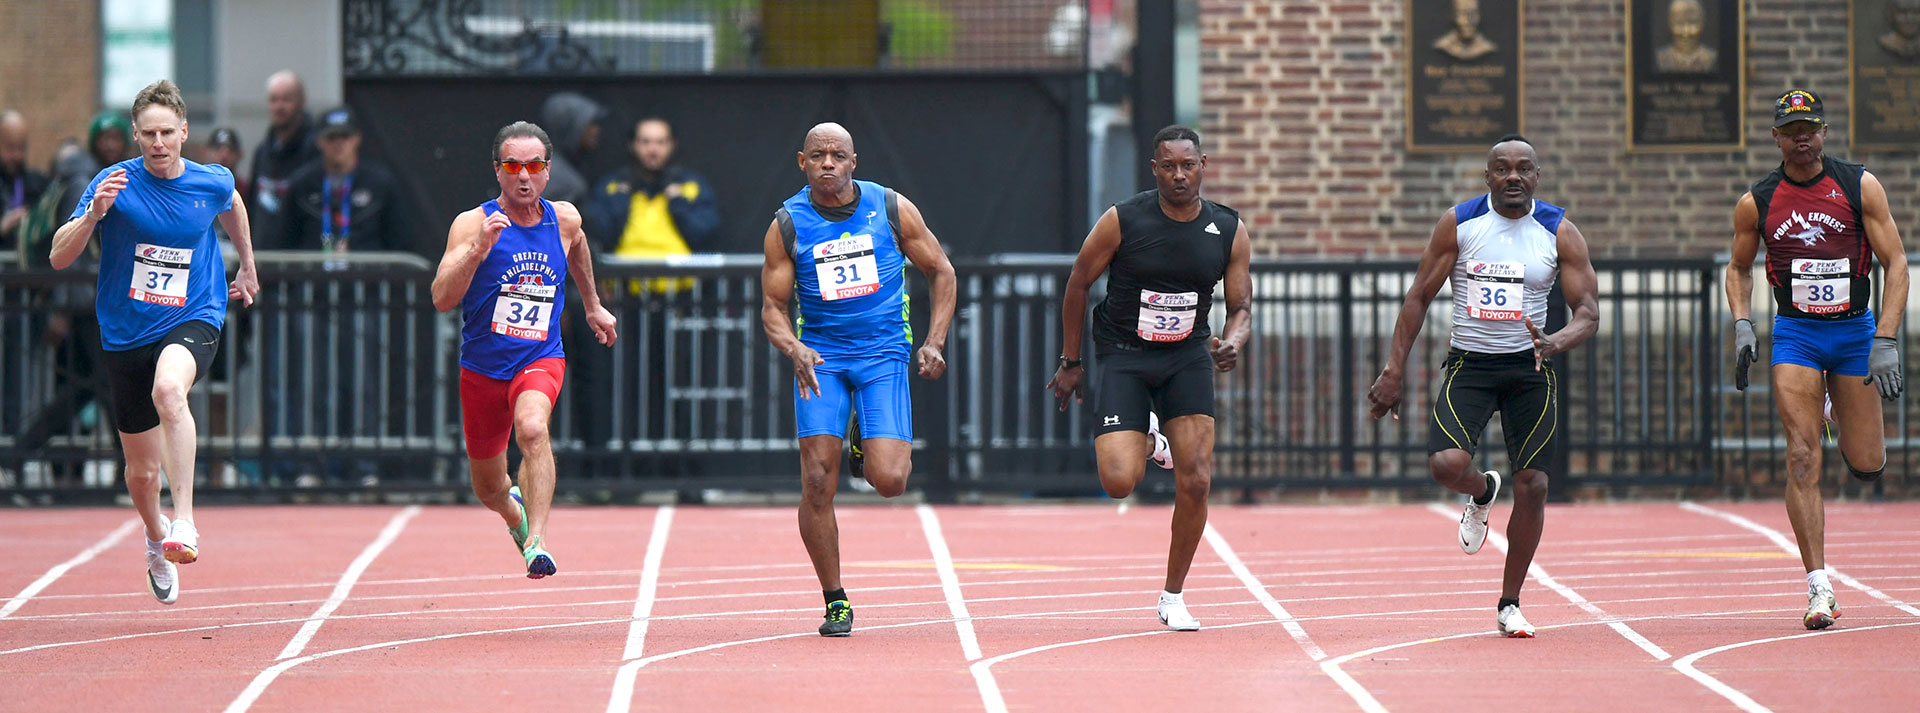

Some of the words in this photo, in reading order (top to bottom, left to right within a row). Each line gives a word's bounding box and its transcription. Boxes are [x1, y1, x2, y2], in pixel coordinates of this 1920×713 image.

[1790, 91, 1815, 103] AIRBORNE
[1773, 219, 1794, 240] PONY
[1808, 212, 1846, 232] EXPRESS
[838, 244, 865, 252] RELAYS
[513, 252, 548, 263] GREATER
[501, 263, 557, 282] PHILADELPHIA
[834, 264, 861, 284] 31
[146, 271, 173, 290] 37
[839, 286, 874, 297] TOYOTA
[1480, 287, 1506, 306] 36
[1808, 284, 1835, 301] 38
[146, 294, 179, 305] TOYOTA
[506, 302, 540, 326] 34
[1481, 311, 1515, 319] TOYOTA
[1154, 316, 1180, 331] 32
[509, 328, 541, 338] TOYOTA
